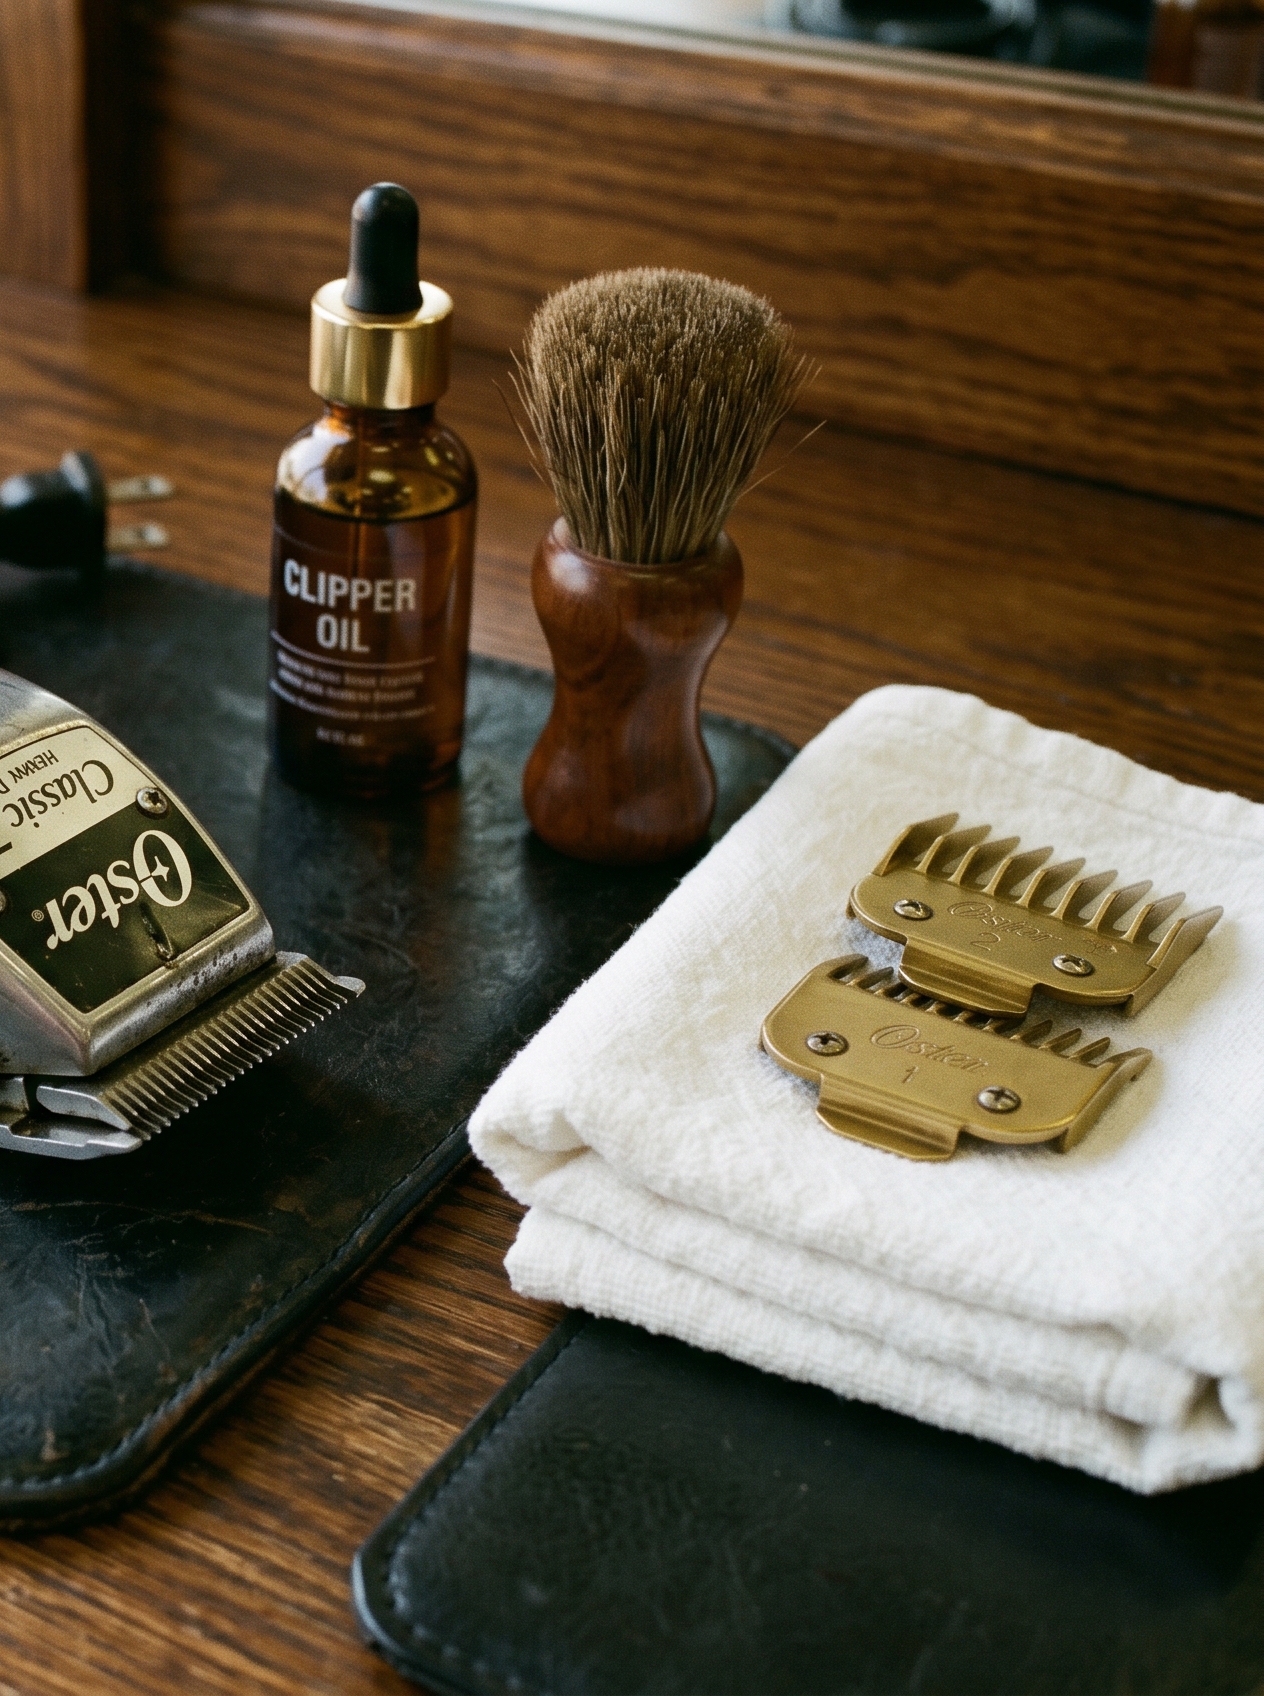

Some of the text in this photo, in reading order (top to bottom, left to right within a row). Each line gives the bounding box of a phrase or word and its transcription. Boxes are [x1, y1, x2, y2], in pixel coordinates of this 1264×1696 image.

[283, 558, 417, 614] CLIPPER
[315, 613, 371, 654] OIL
[2, 759, 114, 829] Classic
[970, 932, 1001, 951] 2
[870, 1025, 989, 1073] Oster
[902, 1066, 920, 1084] 1
